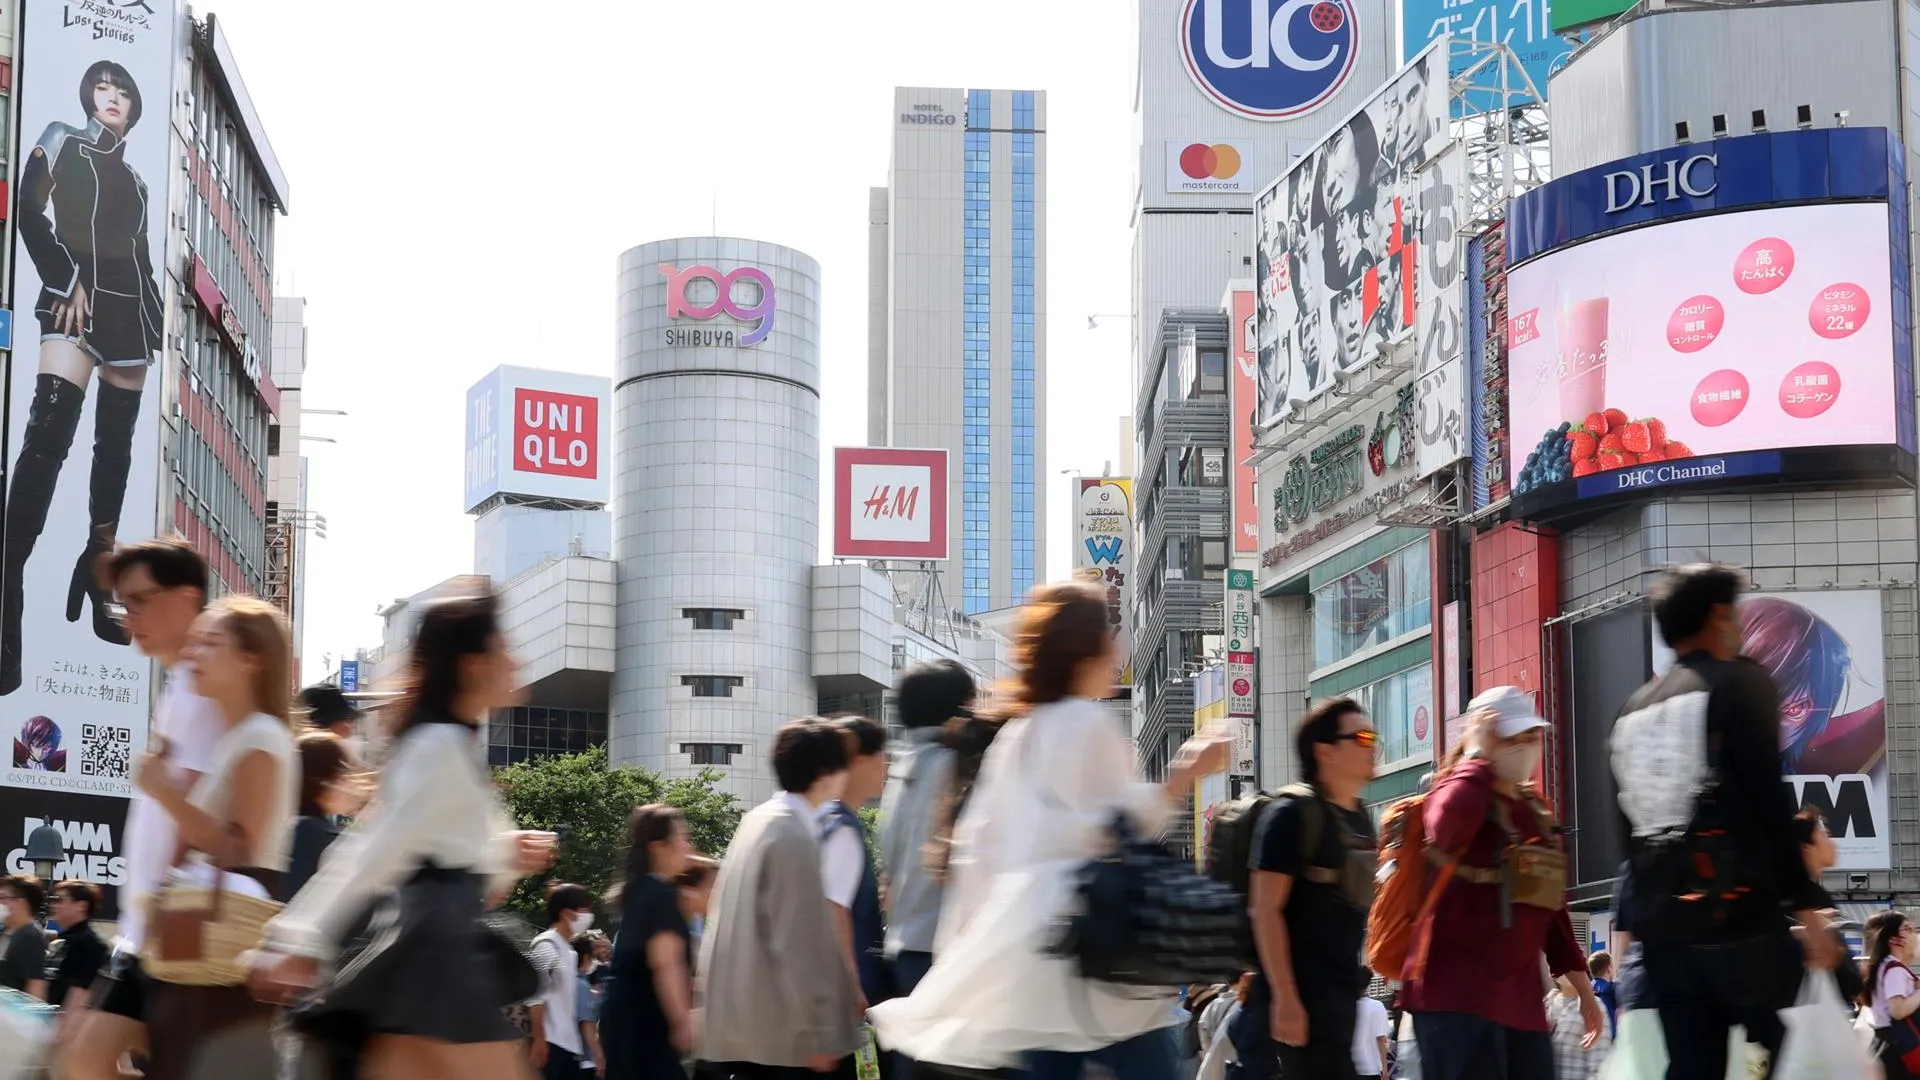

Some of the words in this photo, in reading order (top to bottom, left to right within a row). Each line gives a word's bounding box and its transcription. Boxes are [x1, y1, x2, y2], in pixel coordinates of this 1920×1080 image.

[63, 5, 92, 28] Lost
[93, 19, 134, 44] Stories
[913, 104, 944, 112] HOTEL
[901, 113, 956, 125] INDIGO
[1182, 181, 1239, 190] mastercard
[1604, 153, 1719, 215] DHC
[1755, 249, 1773, 266] 高
[658, 263, 776, 346] 109
[1823, 290, 1856, 301] ビタミン
[1419, 162, 1460, 456] もんじゃ
[1679, 304, 1715, 317] カロリー
[1823, 303, 1857, 313] ミネラル
[1514, 313, 1533, 332] 167
[665, 329, 734, 346] SHIBUYA
[1672, 333, 1715, 345] コントロール
[1697, 389, 1742, 404] 食物繊維
[1786, 392, 1834, 404] コラーゲン
[474, 388, 492, 442] THE
[523, 399, 583, 433] UNI
[523, 434, 588, 468] QLO
[467, 434, 497, 493] PRIME
[1618, 469, 1654, 488] DHC
[1657, 460, 1726, 482] Channel
[864, 484, 919, 520] H&M
[52, 660, 140, 683] これは、きみの
[34, 675, 140, 705] 「失われた物語」
